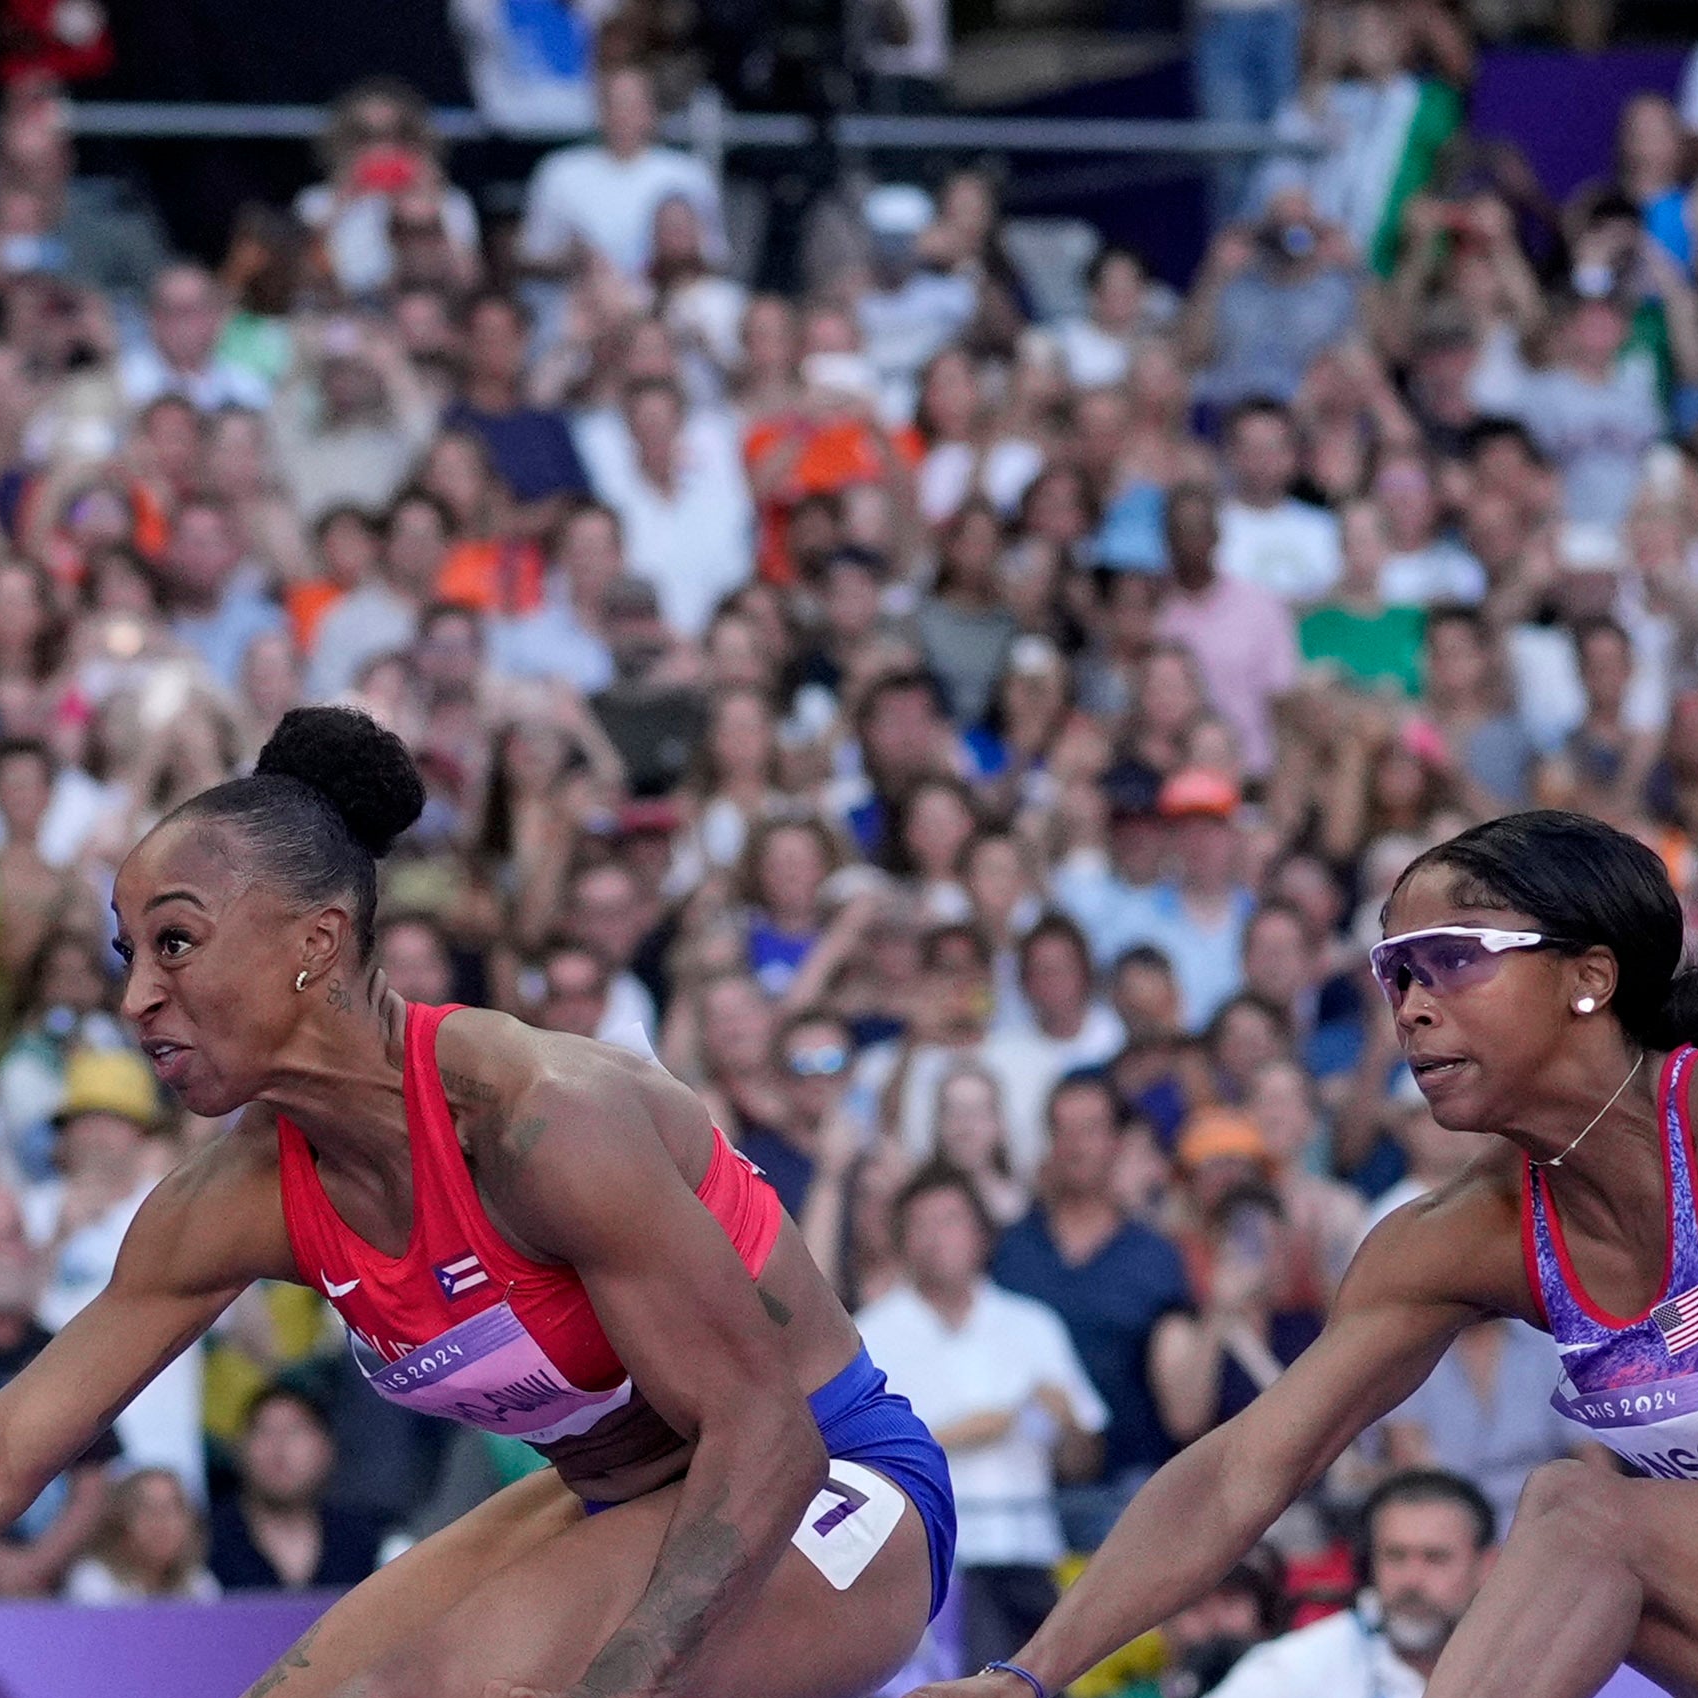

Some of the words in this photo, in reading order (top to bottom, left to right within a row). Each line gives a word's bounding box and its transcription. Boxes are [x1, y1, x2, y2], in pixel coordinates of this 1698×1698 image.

[407, 1344, 464, 1380] 2024
[1619, 1390, 1677, 1417] 2024
[811, 1477, 871, 1538] 7
